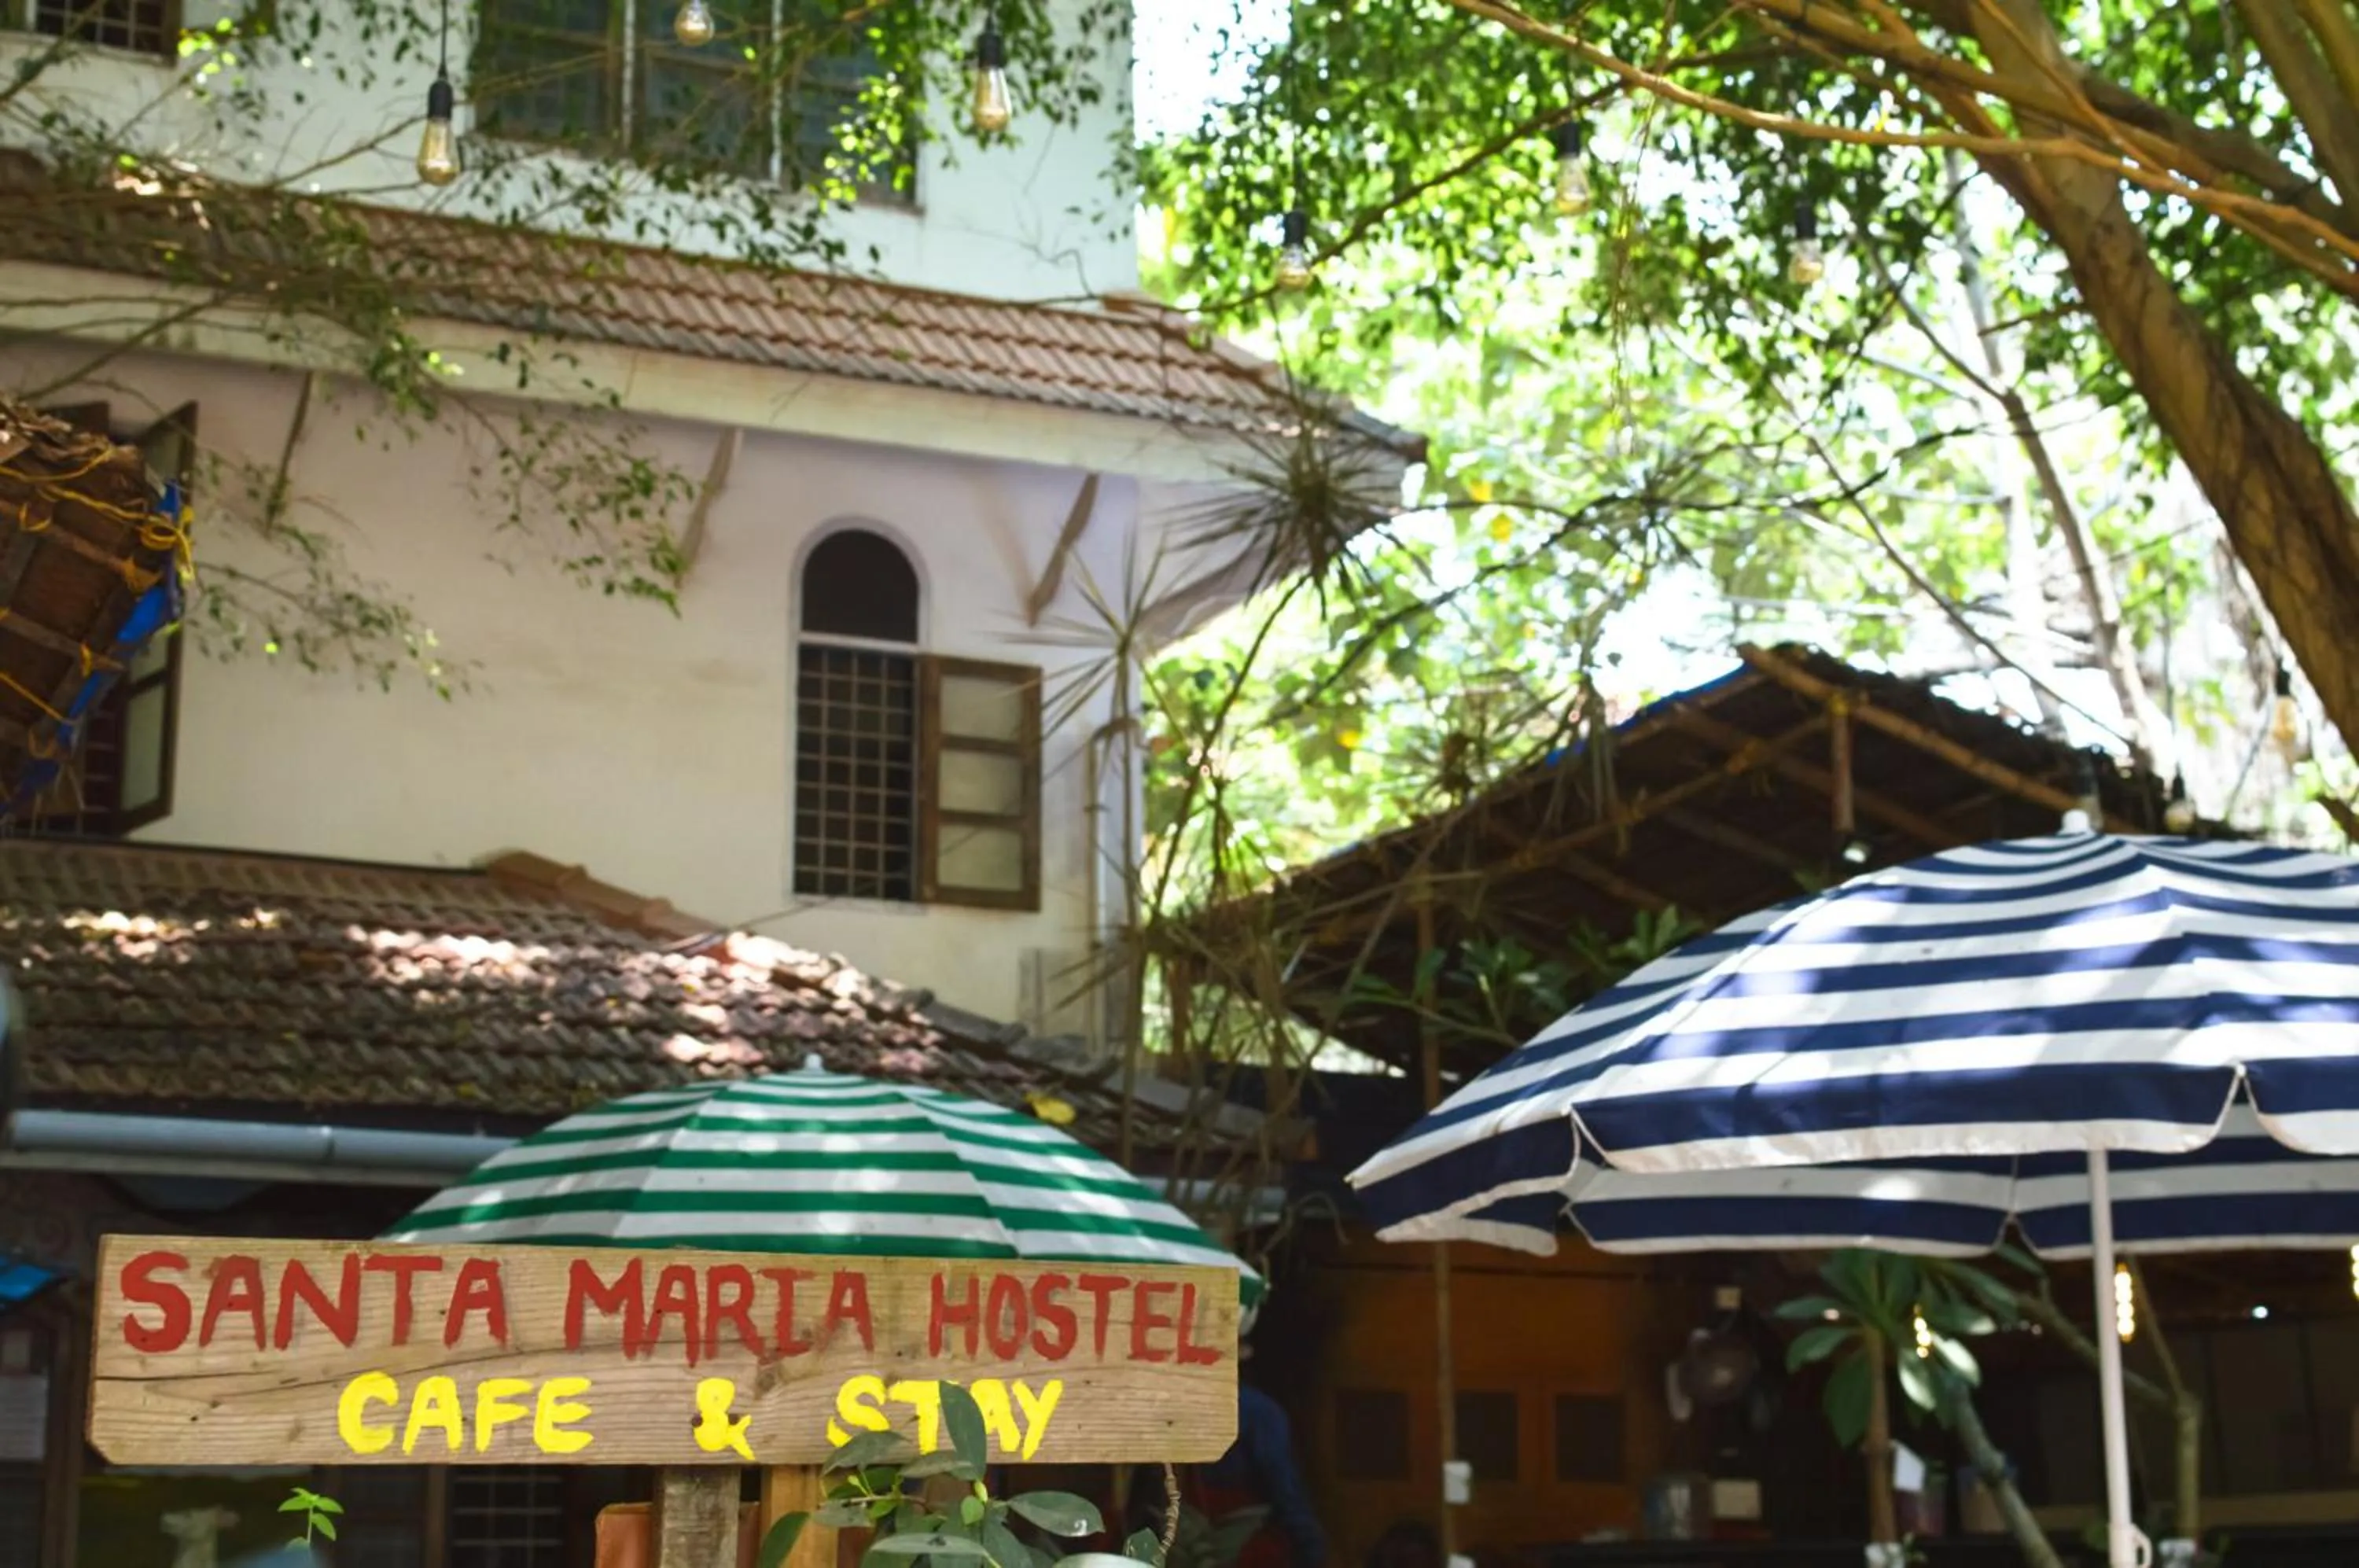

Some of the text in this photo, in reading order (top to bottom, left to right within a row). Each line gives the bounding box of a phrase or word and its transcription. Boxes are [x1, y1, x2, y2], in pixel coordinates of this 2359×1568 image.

[120, 1251, 1222, 1367] SANTA MARIA HOSTEL
[337, 1371, 1064, 1460] CAFE & STAY
